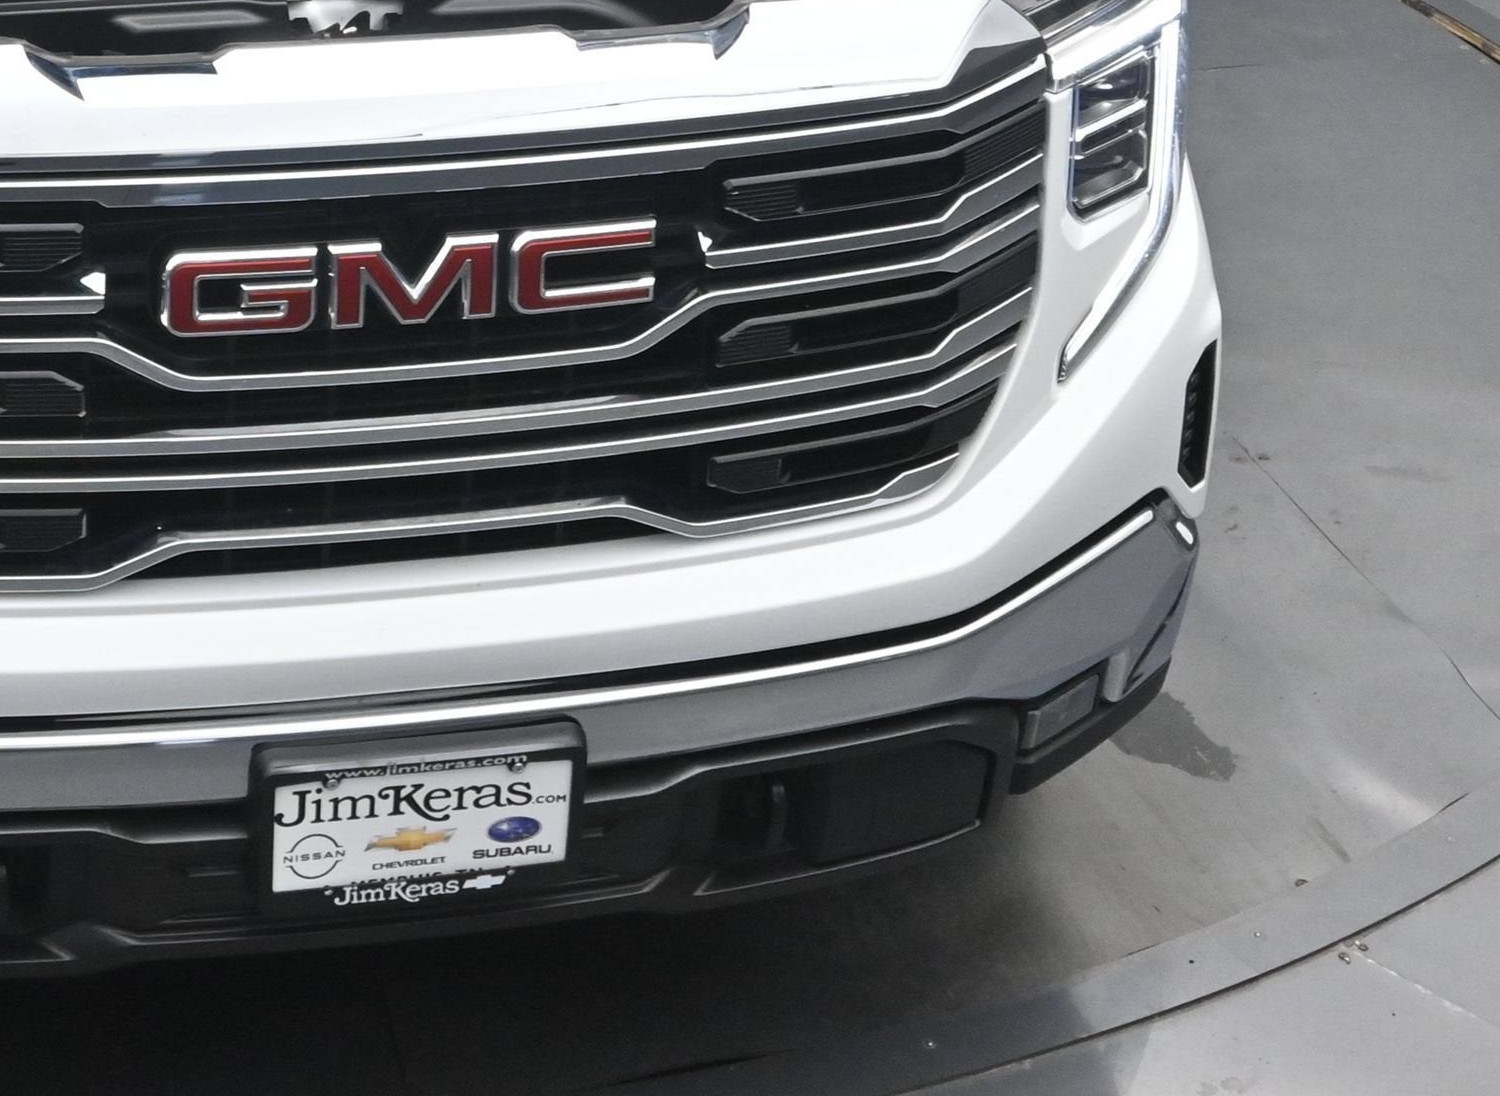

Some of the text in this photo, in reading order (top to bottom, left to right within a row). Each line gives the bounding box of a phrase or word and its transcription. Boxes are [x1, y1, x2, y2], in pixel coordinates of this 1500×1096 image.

[160, 214, 657, 339] GMC
[325, 754, 528, 780] www.jimkeras.com
[283, 849, 346, 865] NISSAN
[472, 844, 553, 860] SUBARU
[372, 856, 446, 870] CHEVROLET
